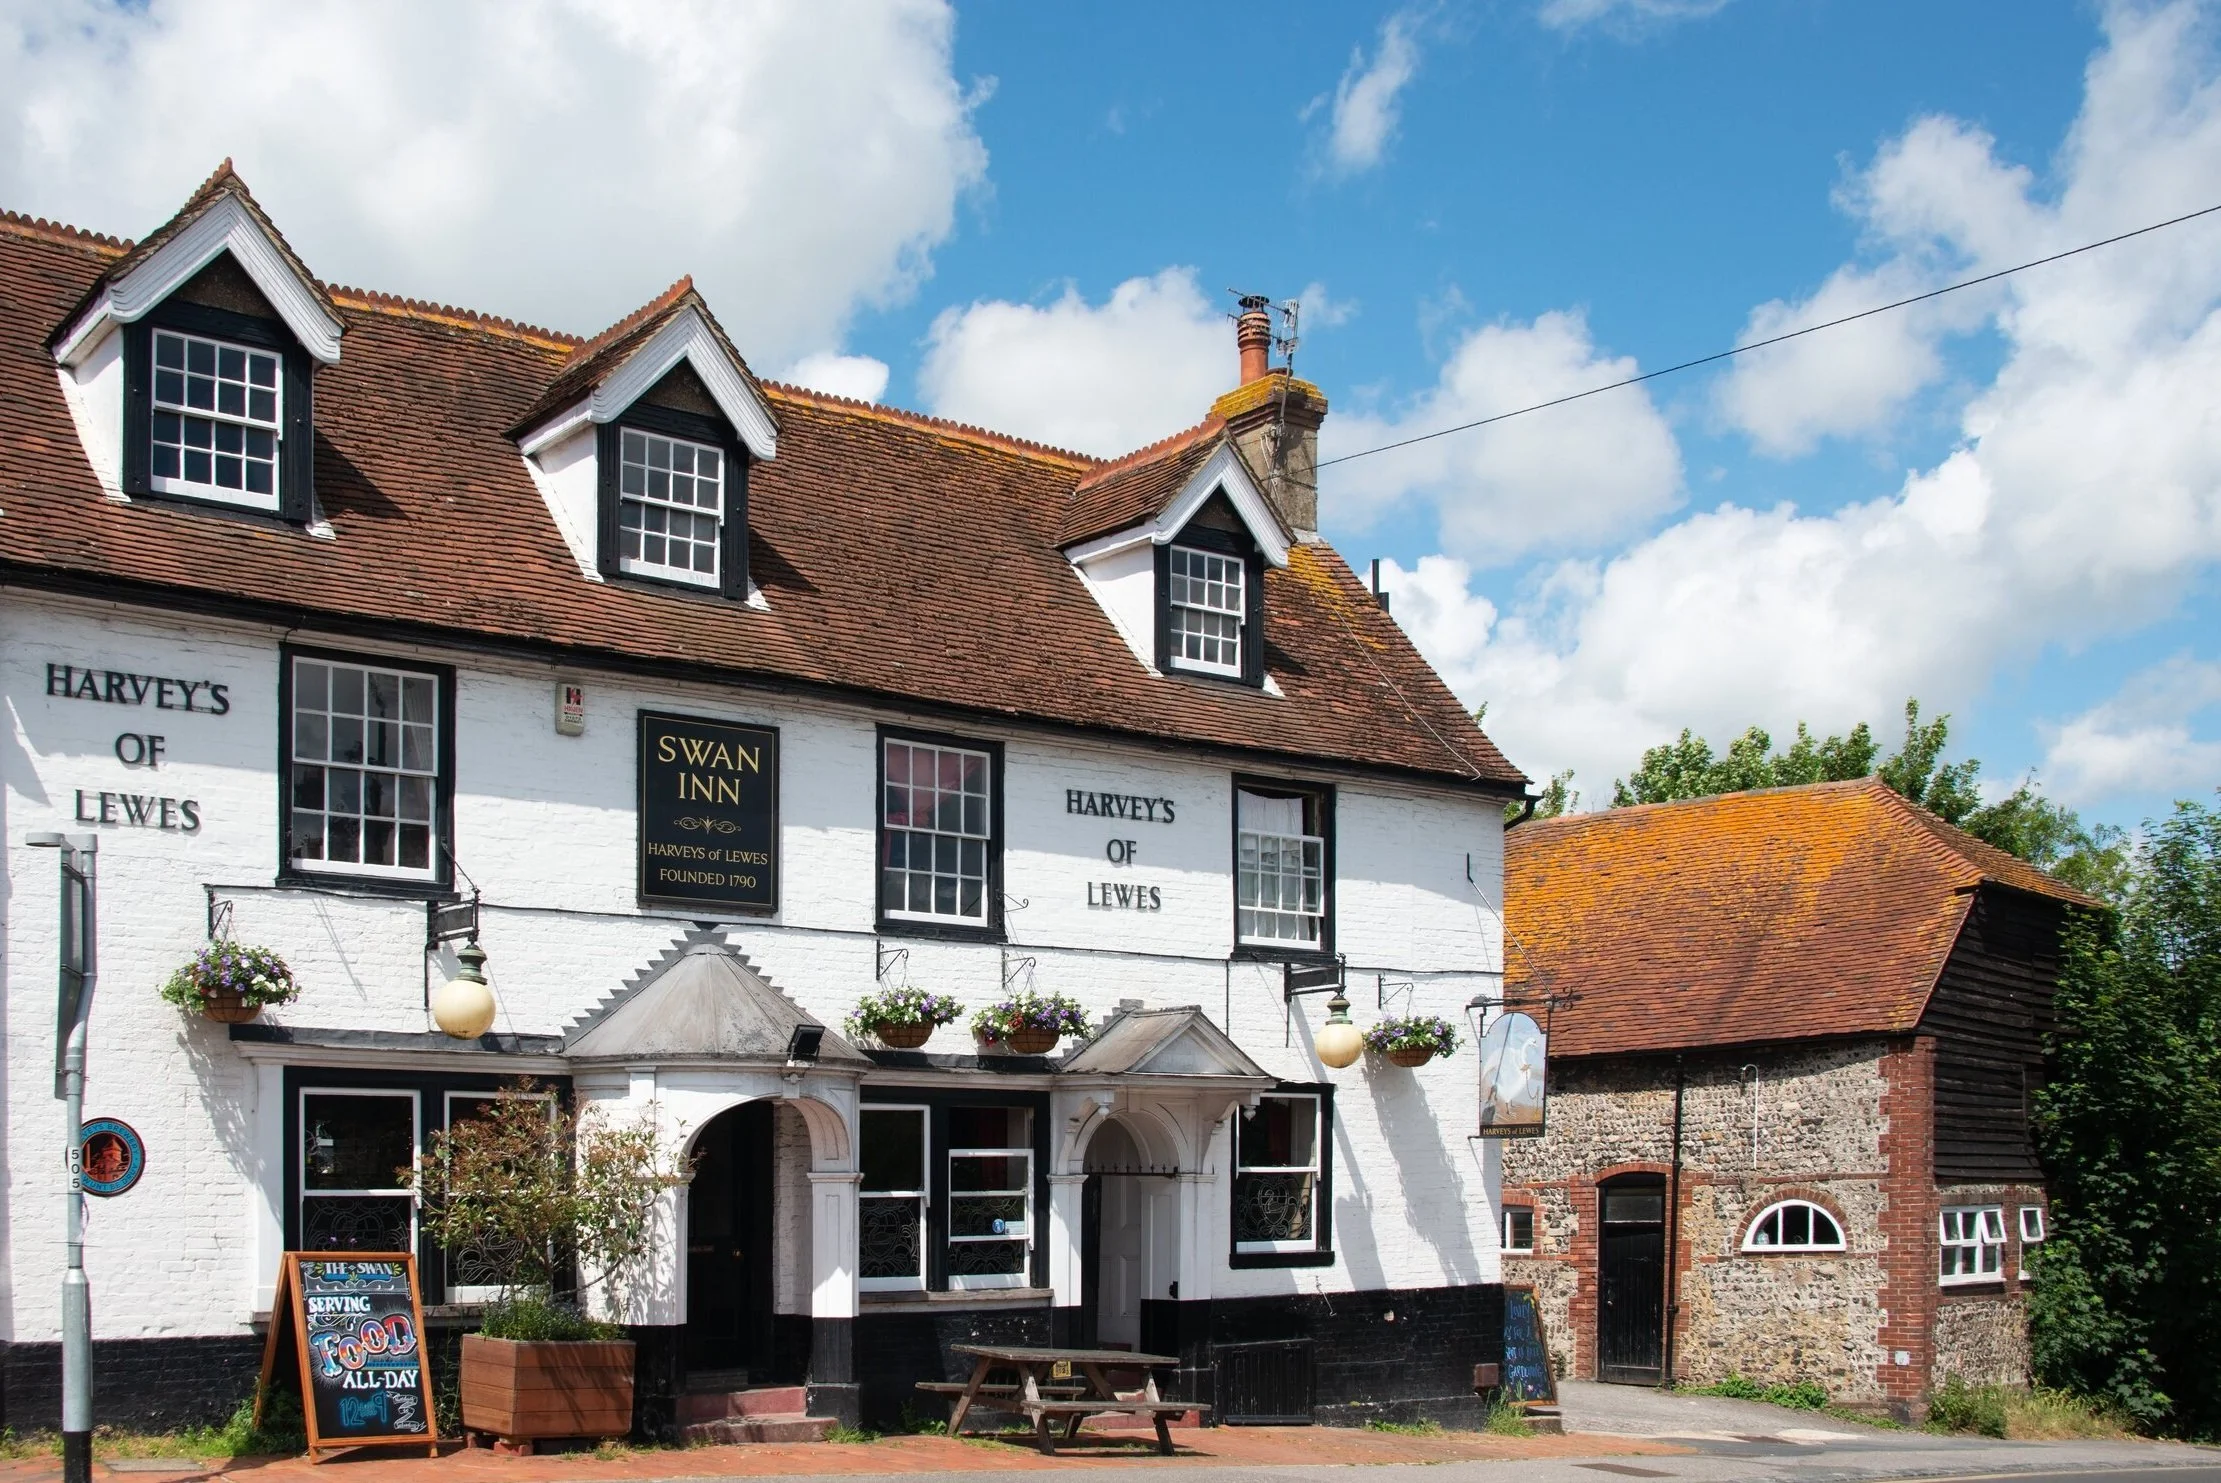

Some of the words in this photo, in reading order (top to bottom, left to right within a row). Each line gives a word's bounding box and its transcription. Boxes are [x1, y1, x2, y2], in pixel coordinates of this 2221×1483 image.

[47, 662, 230, 715] HARVEY'S
[115, 732, 165, 767] OF
[658, 735, 760, 774] SWAN
[679, 772, 741, 806] INN
[75, 788, 200, 831] LEWES
[1066, 789, 1175, 824] HARVEY'S
[648, 842, 705, 860] HARVEYS
[708, 849, 722, 861] of
[725, 850, 768, 865] LEWES
[1106, 839, 1137, 865] OF
[660, 868, 725, 886] FOUNDED
[729, 874, 757, 889] 1790
[1087, 881, 1161, 909] LEWES
[1483, 1127, 1511, 1136] HARVEYS
[1519, 1126, 1540, 1135] LEWES
[322, 1261, 348, 1275] THE
[356, 1262, 394, 1276] SWAN
[307, 1296, 371, 1313] SERVING
[309, 1313, 417, 1378] FOOD
[339, 1396, 365, 1427] 12
